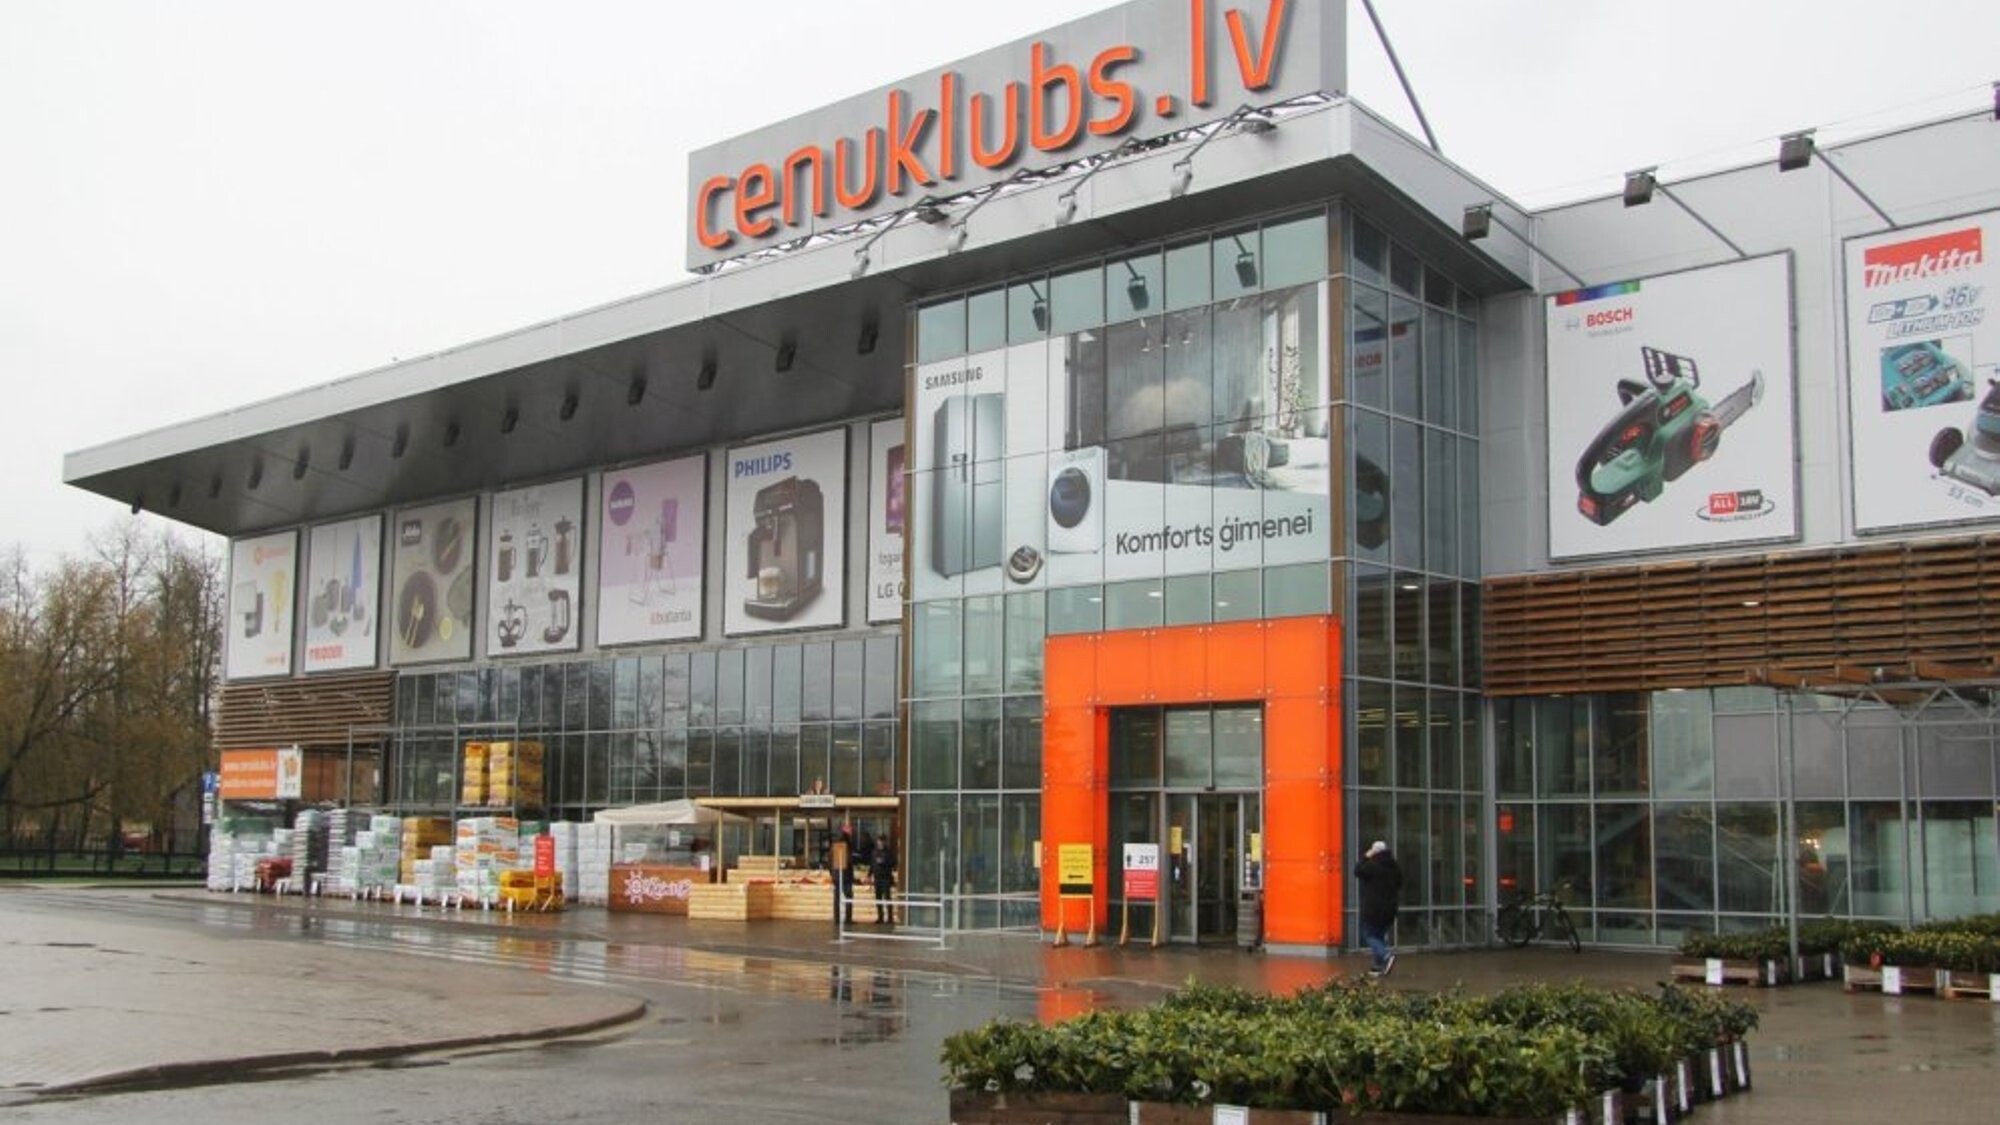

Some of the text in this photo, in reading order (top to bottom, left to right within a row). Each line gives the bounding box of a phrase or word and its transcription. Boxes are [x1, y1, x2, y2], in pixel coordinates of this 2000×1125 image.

[697, 0, 1285, 248] cenuklubs.lv
[1586, 307, 1634, 328] BOSCH
[925, 366, 983, 390] SAMSUNG
[735, 452, 792, 478] PHILIPS
[1116, 508, 1313, 555] Komforts ģimenei
[877, 582, 894, 599] LG
